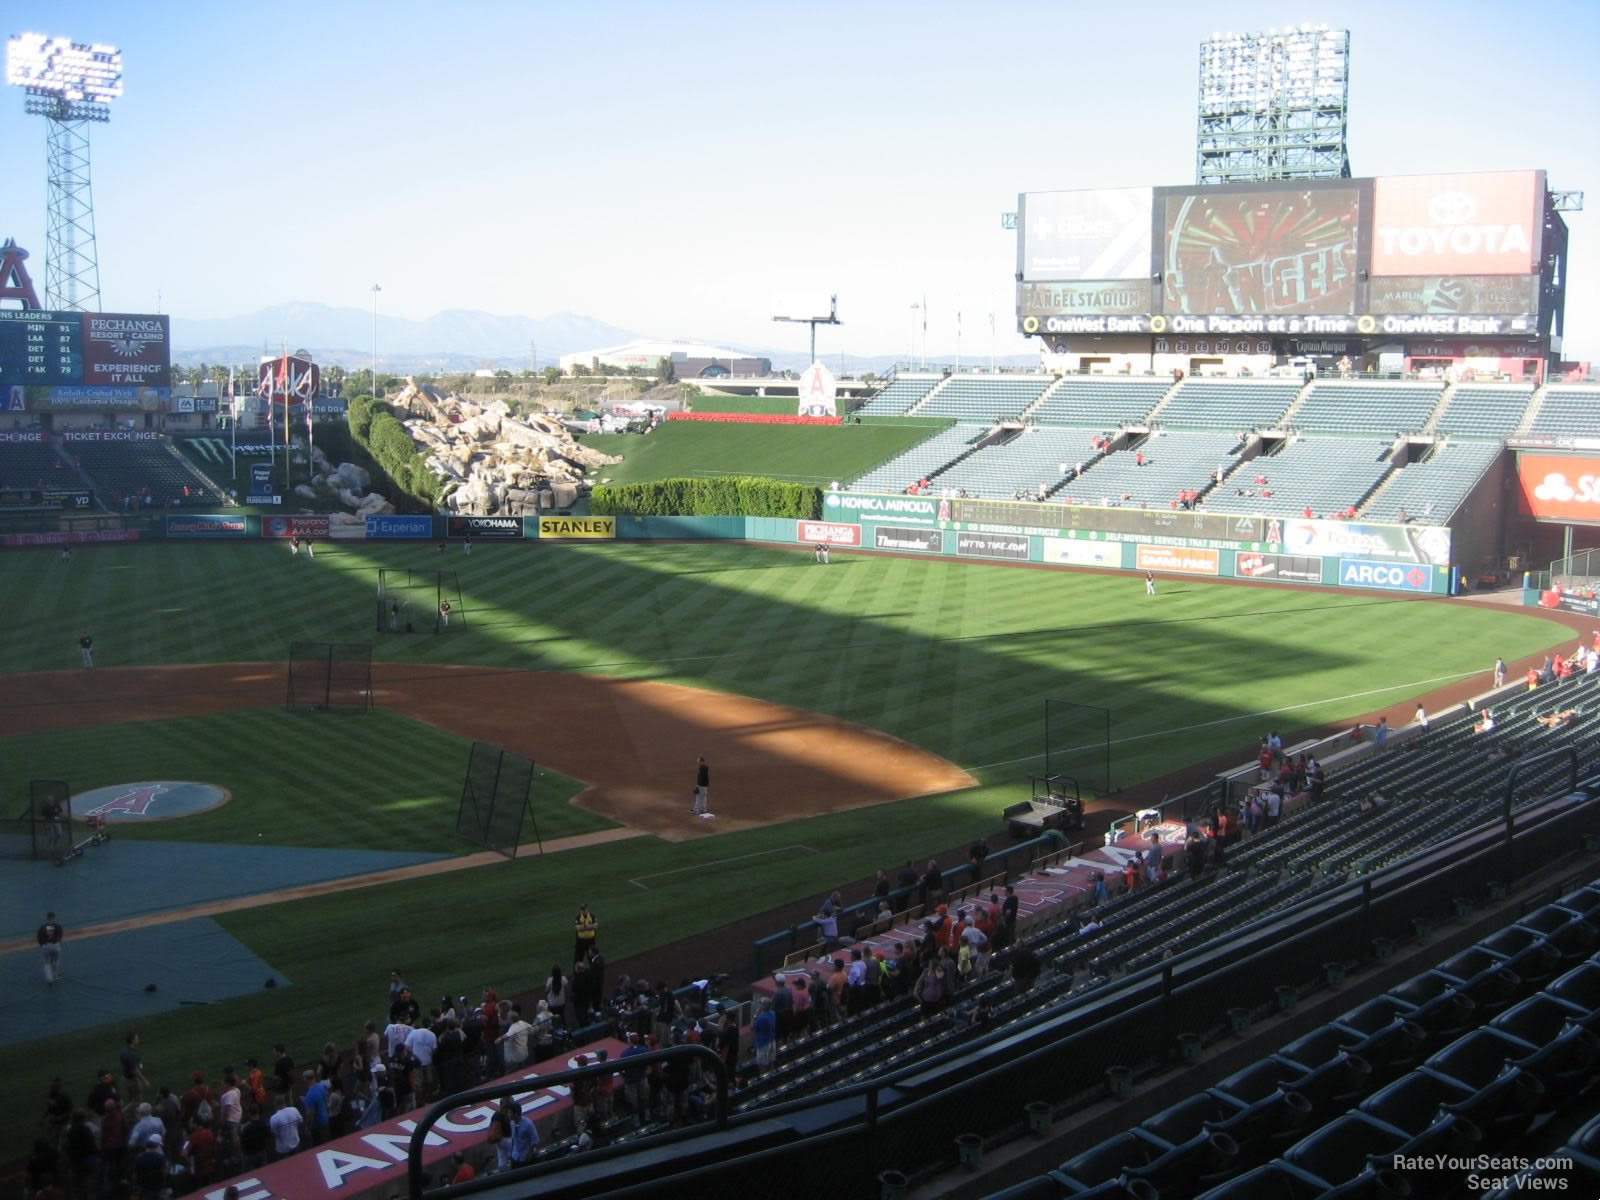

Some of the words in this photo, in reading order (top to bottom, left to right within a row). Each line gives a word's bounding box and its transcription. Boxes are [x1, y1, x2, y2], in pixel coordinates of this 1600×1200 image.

[1381, 224, 1529, 256] TOYOTA
[1032, 288, 1076, 308] ANGEL
[1078, 289, 1140, 308] STADIUM
[15, 312, 52, 320] LEADERS
[91, 319, 163, 331] PECHANGA
[1047, 316, 1105, 332] OneWest
[1107, 316, 1142, 332] Bank
[1172, 316, 1205, 331] One
[1209, 316, 1264, 333] Person
[1384, 316, 1455, 333] OneWest
[1458, 316, 1501, 333] Bank
[1159, 343, 1166, 351] 11
[1177, 343, 1187, 351] 26
[1217, 343, 1227, 351] 30
[1238, 343, 1248, 351] 42
[1259, 343, 1269, 351] 50
[112, 375, 124, 383] IT
[125, 375, 145, 383] ALL
[64, 432, 100, 440] TICKET
[842, 497, 884, 511] KONICA
[886, 499, 935, 513] MINOLTA
[381, 522, 425, 532] Experian
[542, 521, 613, 533] STANLEY
[980, 525, 1023, 535] HOUSEHOLD
[960, 539, 985, 549] NITTO
[1154, 536, 1187, 547] SERVICES
[1189, 539, 1207, 548] THAT
[1327, 532, 1385, 548] TOTAL
[1344, 566, 1405, 585] ARCO
